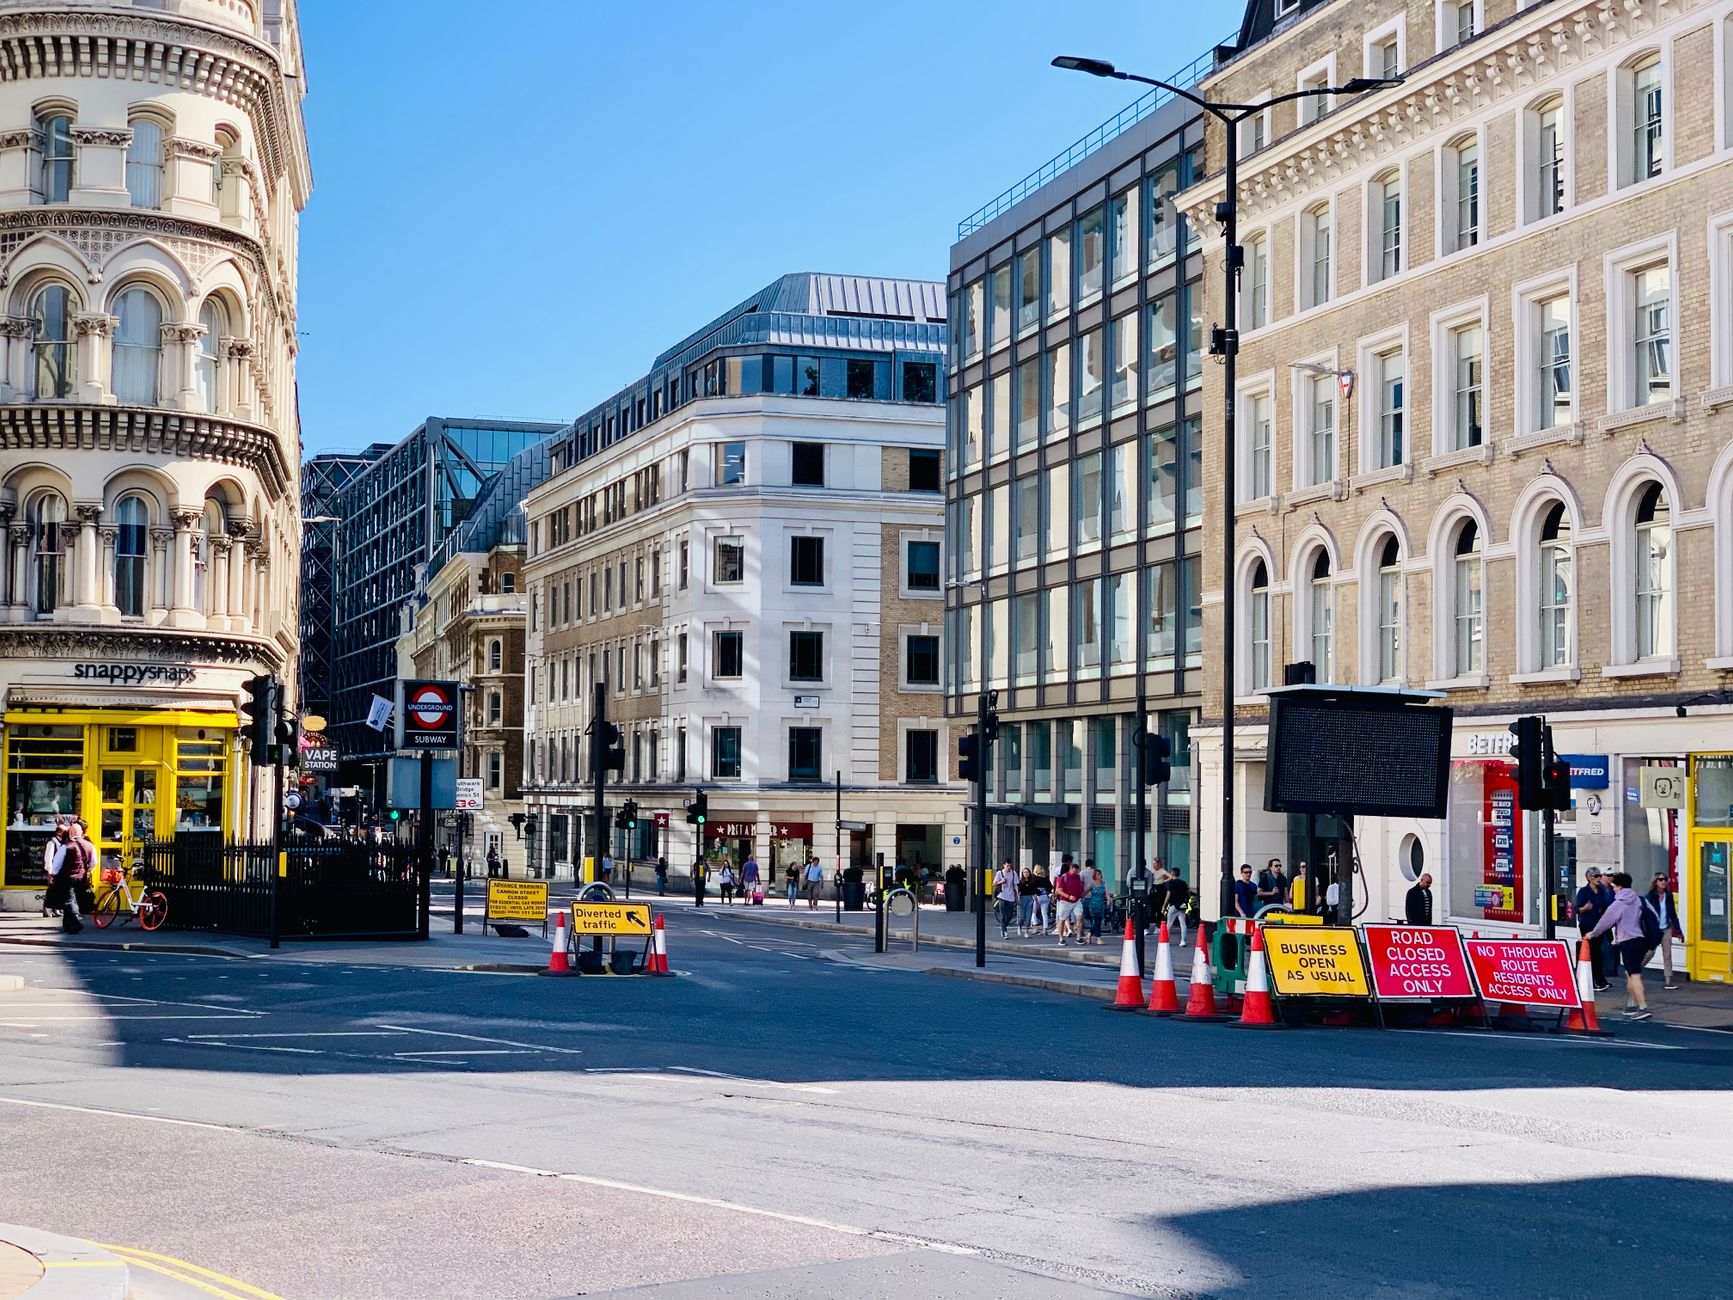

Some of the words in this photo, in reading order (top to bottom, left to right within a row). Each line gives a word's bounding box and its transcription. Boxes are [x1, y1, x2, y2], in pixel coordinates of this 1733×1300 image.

[74, 663, 197, 685] snappysnaps
[414, 735, 447, 743] SUBWAY
[1467, 733, 1518, 754] BETFR
[305, 750, 337, 761] VAPE
[304, 761, 337, 769] STATION
[1570, 767, 1605, 776] ETFRED
[727, 824, 743, 836] PRET
[744, 825, 749, 836] A
[751, 824, 778, 836] MER
[576, 908, 621, 918] Diverted
[583, 920, 617, 929] traffic
[1391, 930, 1433, 944] ROAD
[1280, 944, 1347, 955] BUSINESS
[1386, 947, 1445, 961] CLOSED
[1477, 945, 1495, 957] NO
[1500, 946, 1557, 959] THROUGH
[1299, 957, 1335, 968] OPEN
[1501, 960, 1539, 972] ROUTE
[1287, 970, 1305, 980] AS
[1310, 971, 1355, 982] USUAL
[1390, 963, 1452, 977] ACCESS
[1493, 971, 1554, 986] RESIDENTS
[1403, 979, 1443, 993] ONLY
[1488, 983, 1533, 997] ACCESS
[1538, 987, 1567, 1000] ONLY
